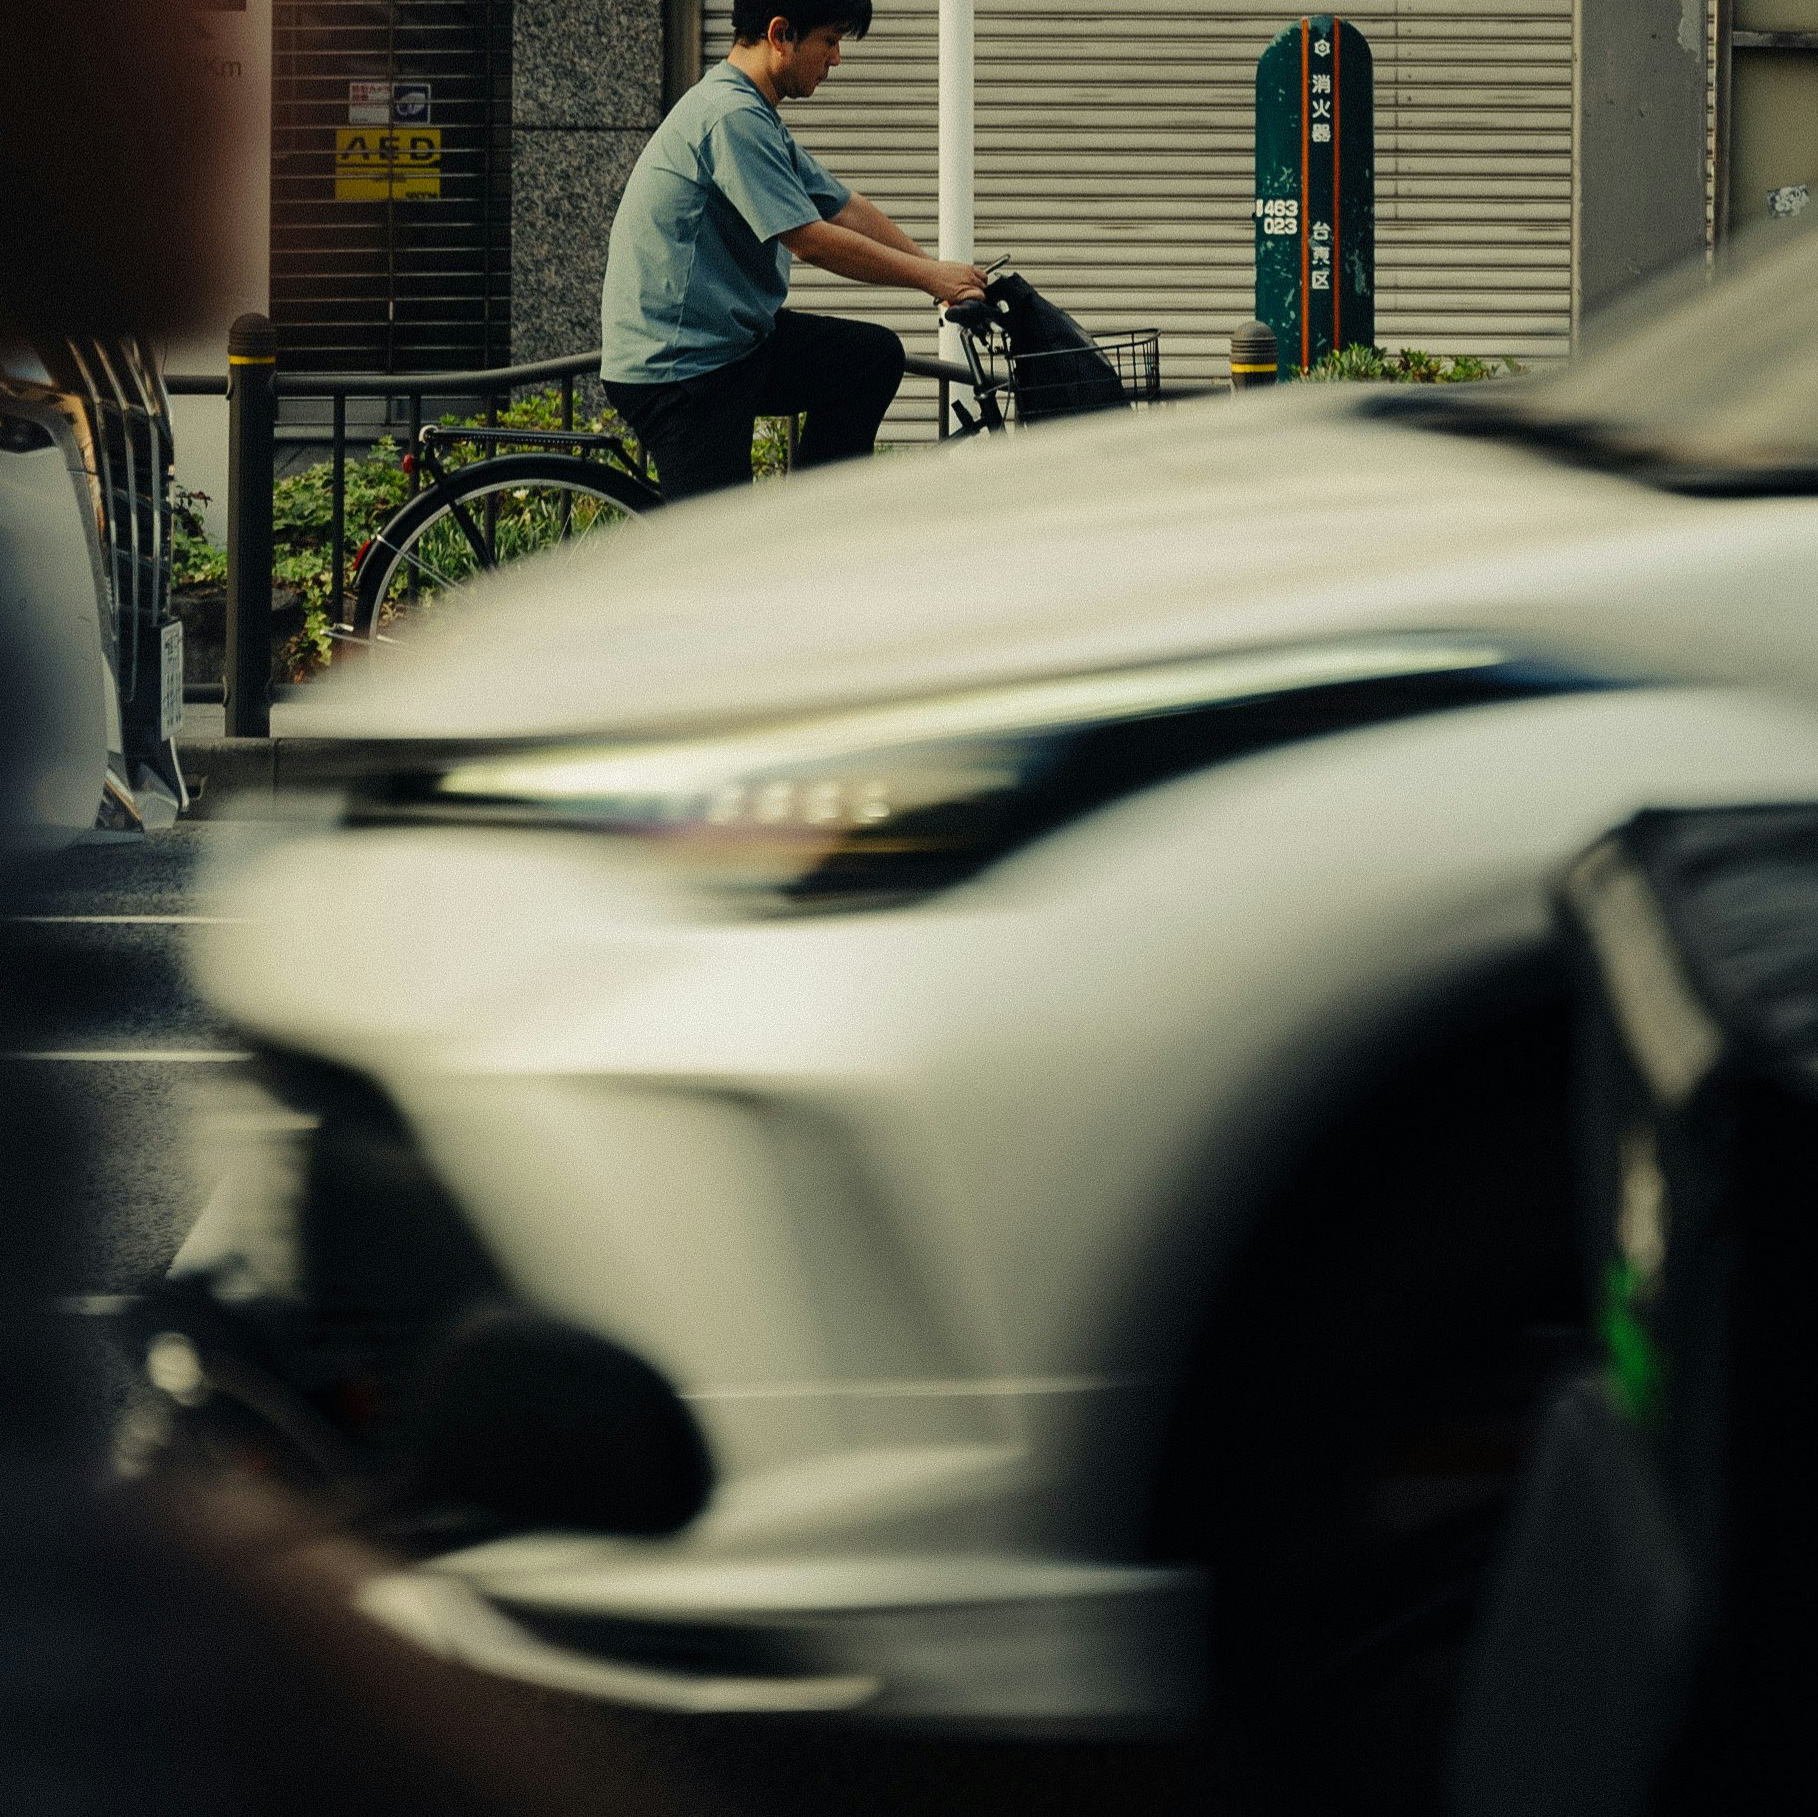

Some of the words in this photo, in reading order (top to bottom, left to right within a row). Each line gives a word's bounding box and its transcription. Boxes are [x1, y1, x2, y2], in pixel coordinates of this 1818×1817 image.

[1310, 73, 1332, 144] 消火器
[340, 136, 436, 161] AED
[1263, 216, 1298, 235] 023
[1310, 220, 1332, 291] 台東区
